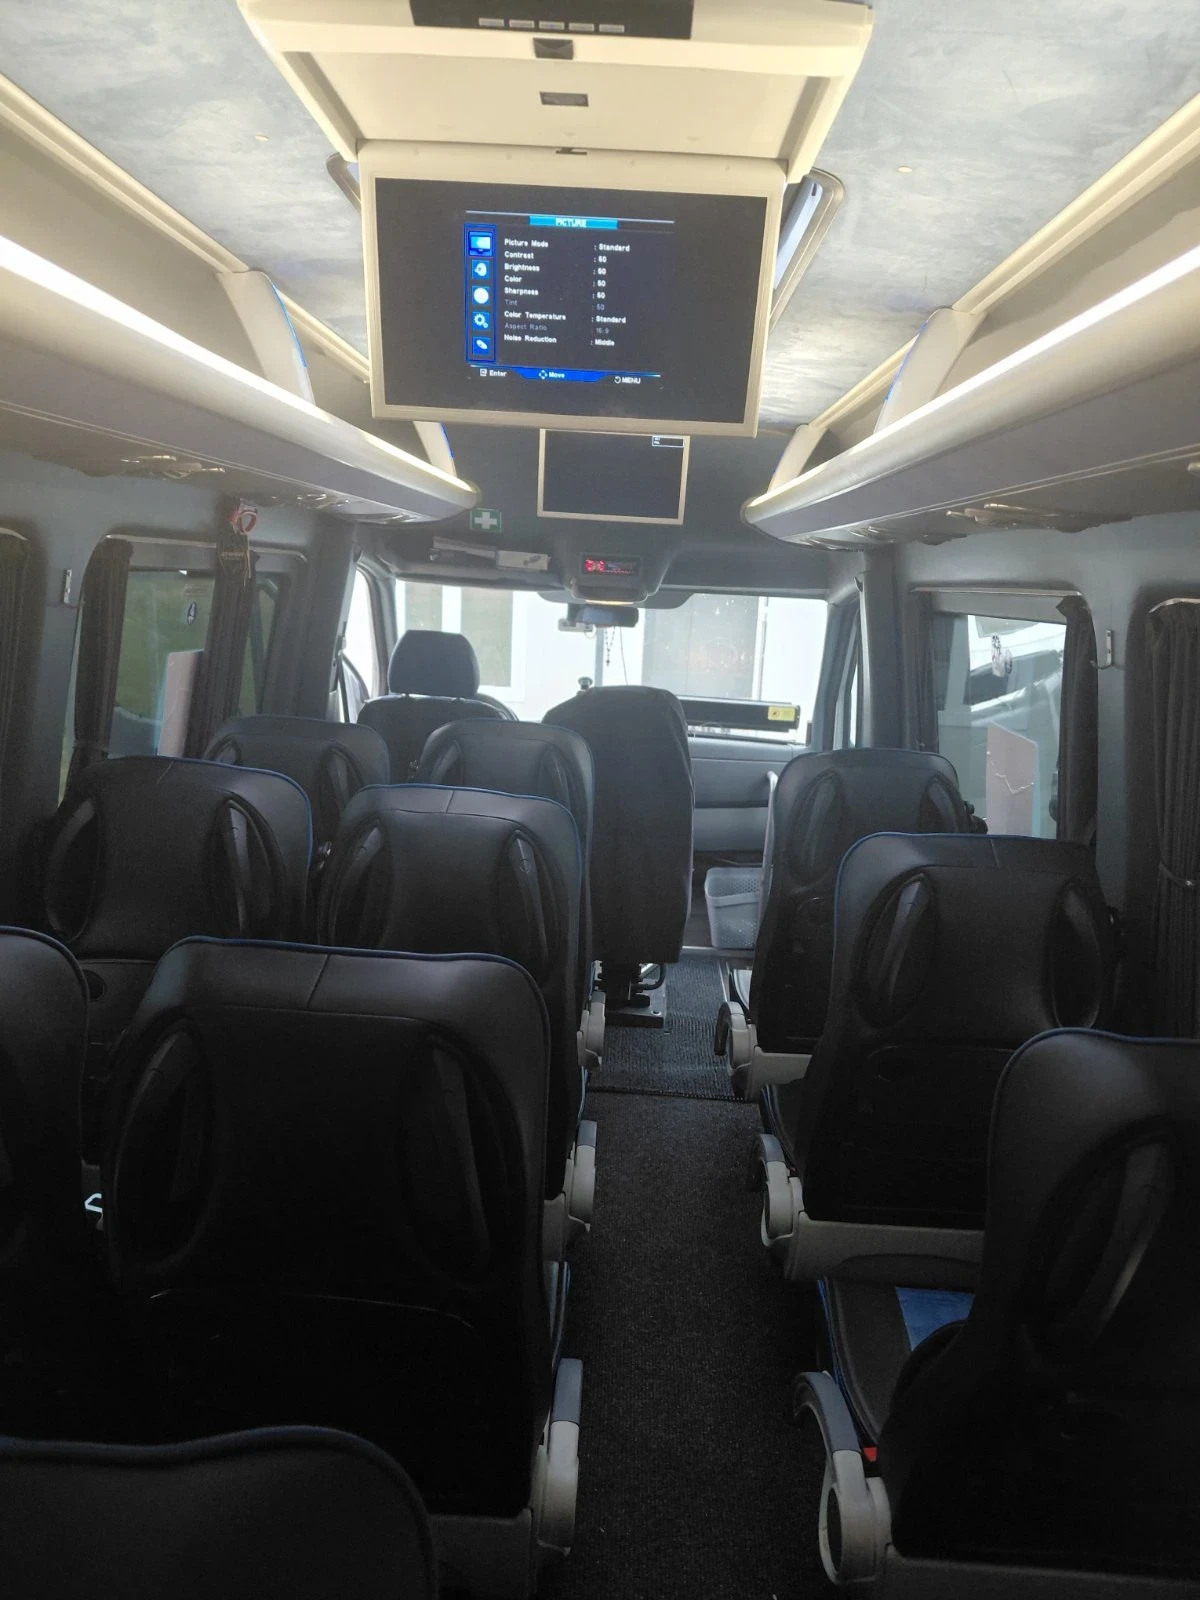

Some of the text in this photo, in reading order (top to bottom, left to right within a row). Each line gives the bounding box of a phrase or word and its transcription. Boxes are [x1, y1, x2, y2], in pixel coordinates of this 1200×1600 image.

[555, 217, 587, 228] PICTURE
[504, 238, 528, 247] Picture
[531, 240, 549, 248] Mode
[598, 243, 630, 252] Standard
[504, 251, 534, 259] Contrast
[504, 263, 540, 272] Brightness
[504, 275, 522, 283] Color
[504, 287, 538, 295] Sharpness
[504, 311, 522, 319] Color
[525, 312, 566, 321] Temperature
[595, 315, 626, 324] Standard
[504, 322, 527, 331] Aspect
[504, 334, 522, 342] Noise
[525, 335, 557, 343] Reduction
[594, 338, 615, 347] Middle
[489, 369, 507, 377] Enter
[548, 371, 565, 379] Move
[621, 376, 641, 384] MENU
